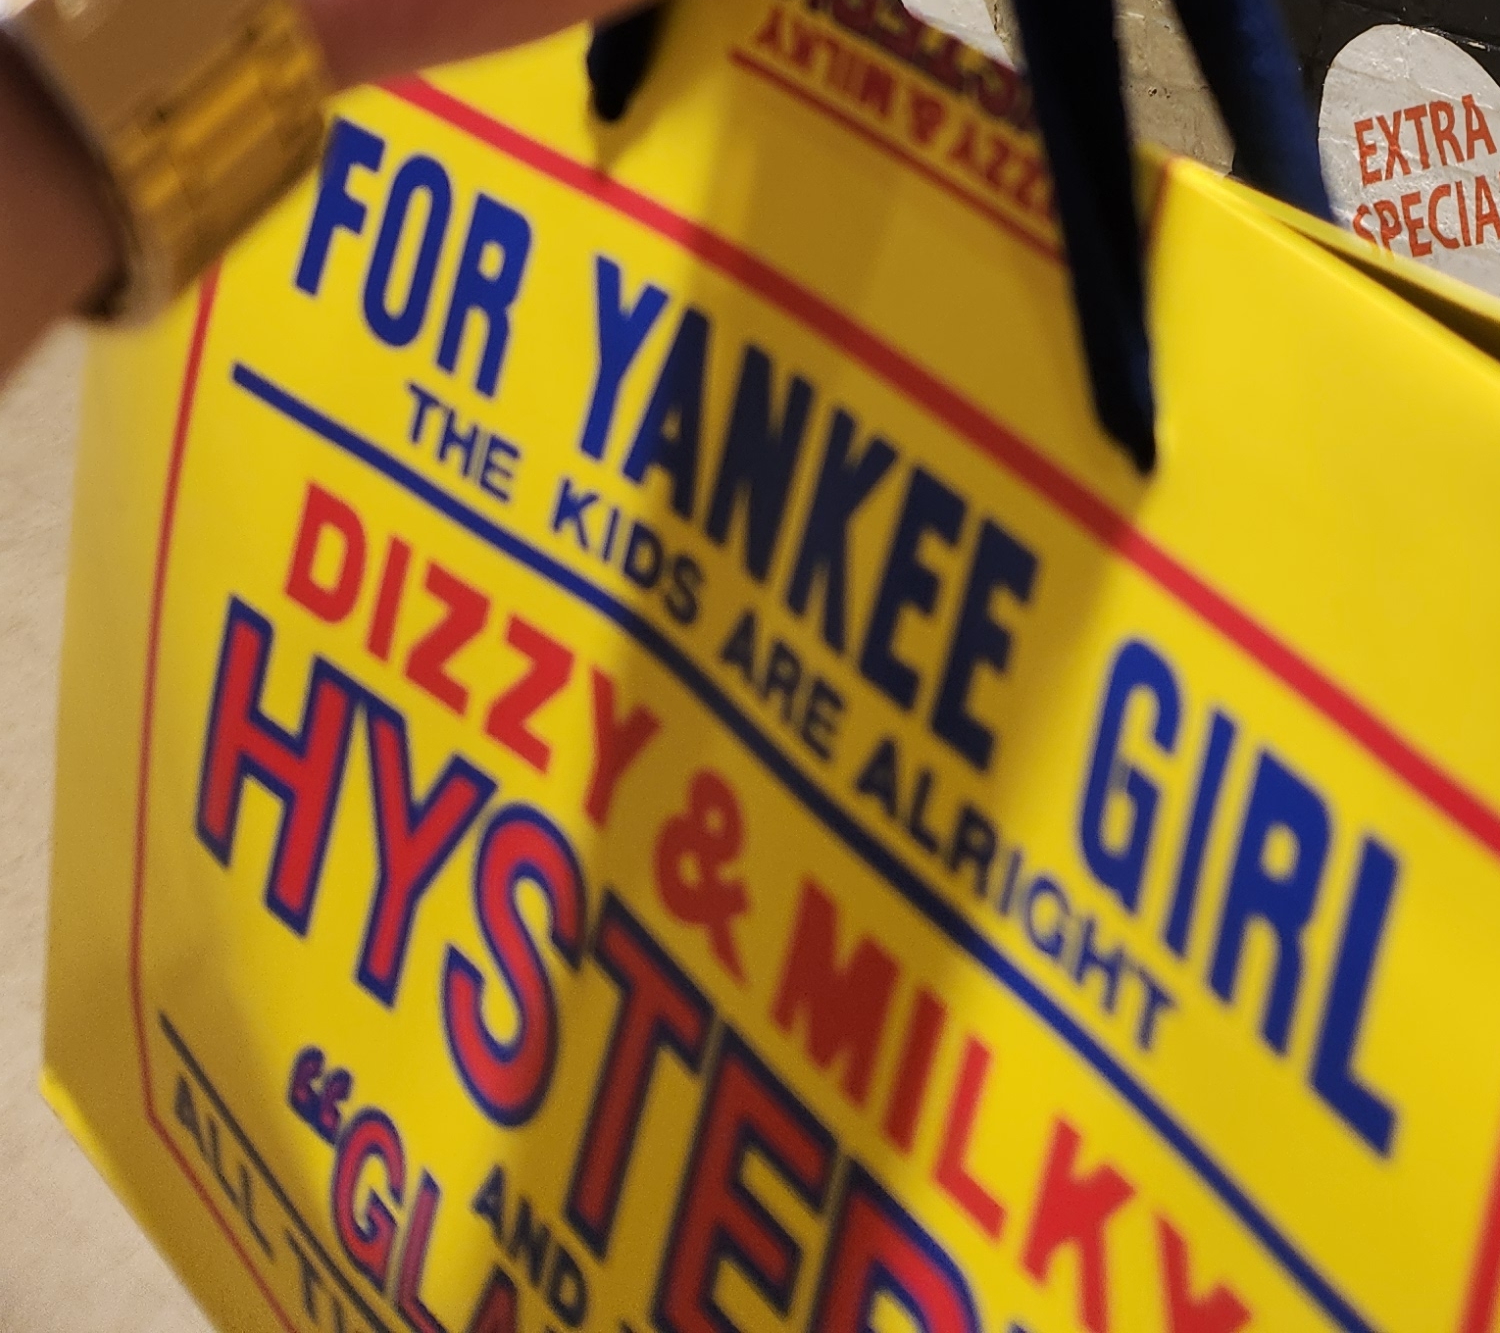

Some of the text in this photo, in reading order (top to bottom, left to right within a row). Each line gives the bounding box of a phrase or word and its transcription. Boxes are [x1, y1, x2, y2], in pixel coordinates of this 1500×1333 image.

[1354, 93, 1499, 188] EXTRA
[282, 477, 1254, 1333] DIZZY & MILKY
[292, 115, 1402, 1164] FOR YANKEE GIRL
[405, 379, 1179, 1054] THE KIDS ARE ALRIGHT
